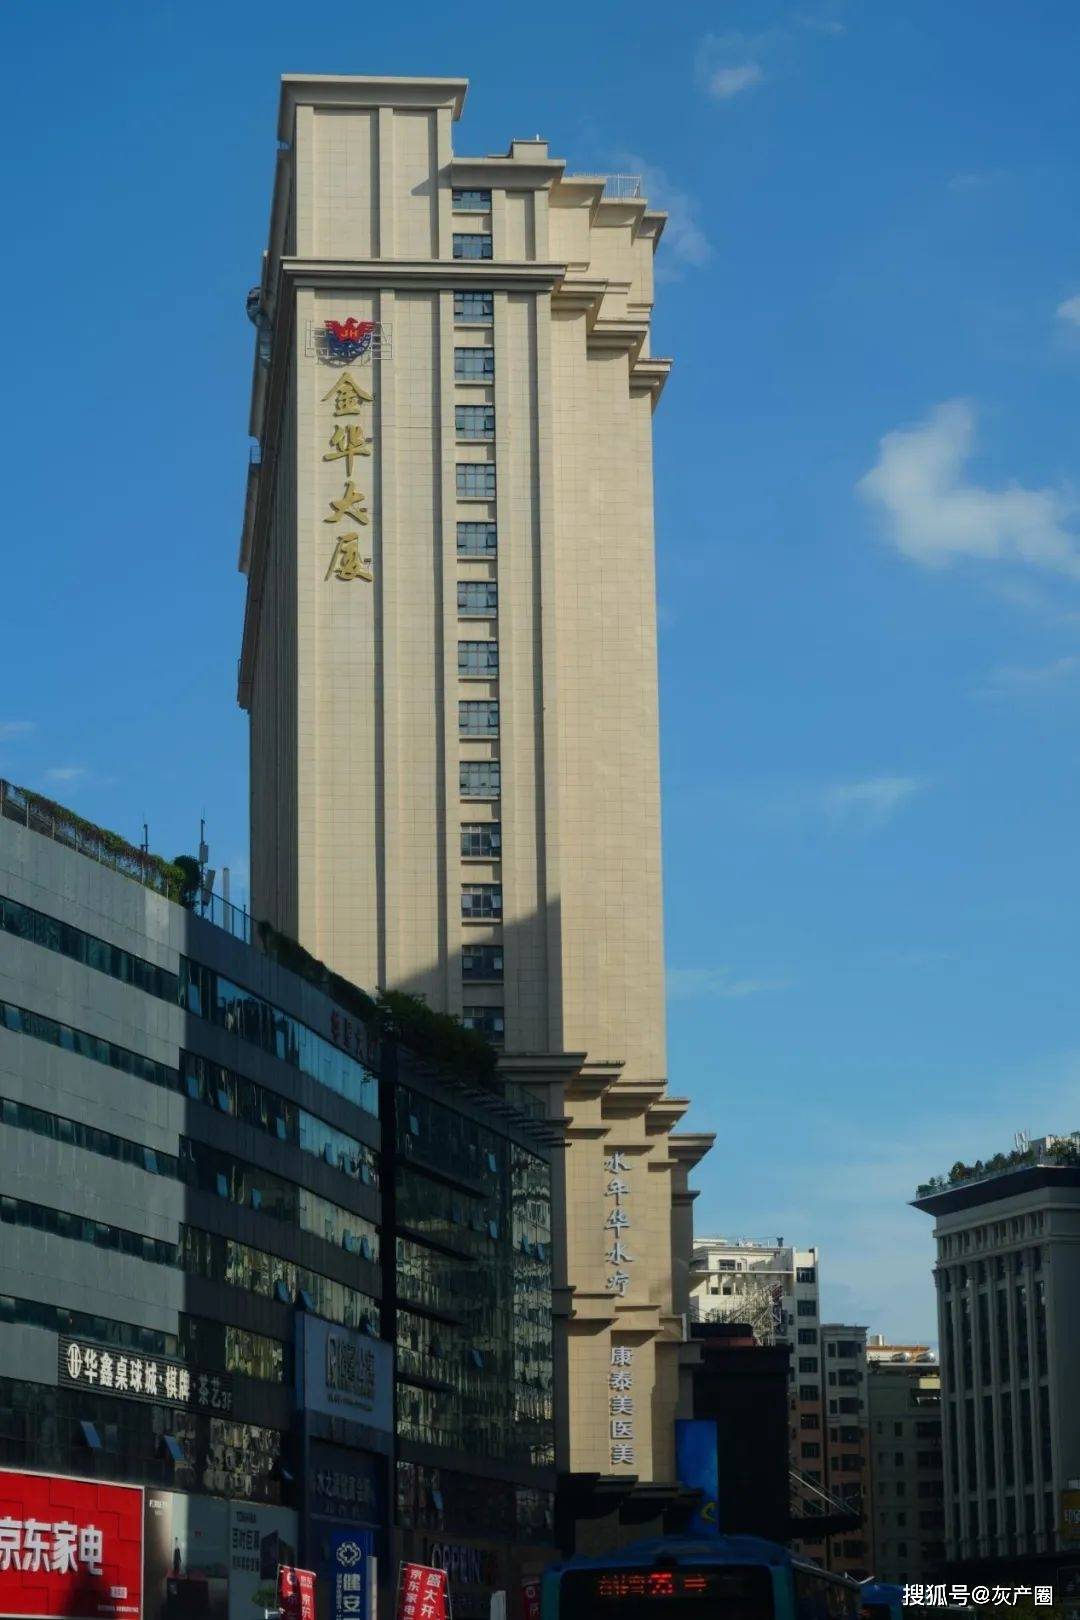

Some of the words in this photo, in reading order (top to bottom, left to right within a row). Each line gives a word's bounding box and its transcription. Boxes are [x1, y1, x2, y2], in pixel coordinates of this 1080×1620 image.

[321, 371, 374, 583] 金华大厦
[604, 1150, 634, 1297] 水年华水疗
[609, 1345, 634, 1465] 康泰美医美
[0, 1515, 103, 1577] 京东家电
[342, 1573, 360, 1620] 健安
[403, 1568, 422, 1620] 京东家电
